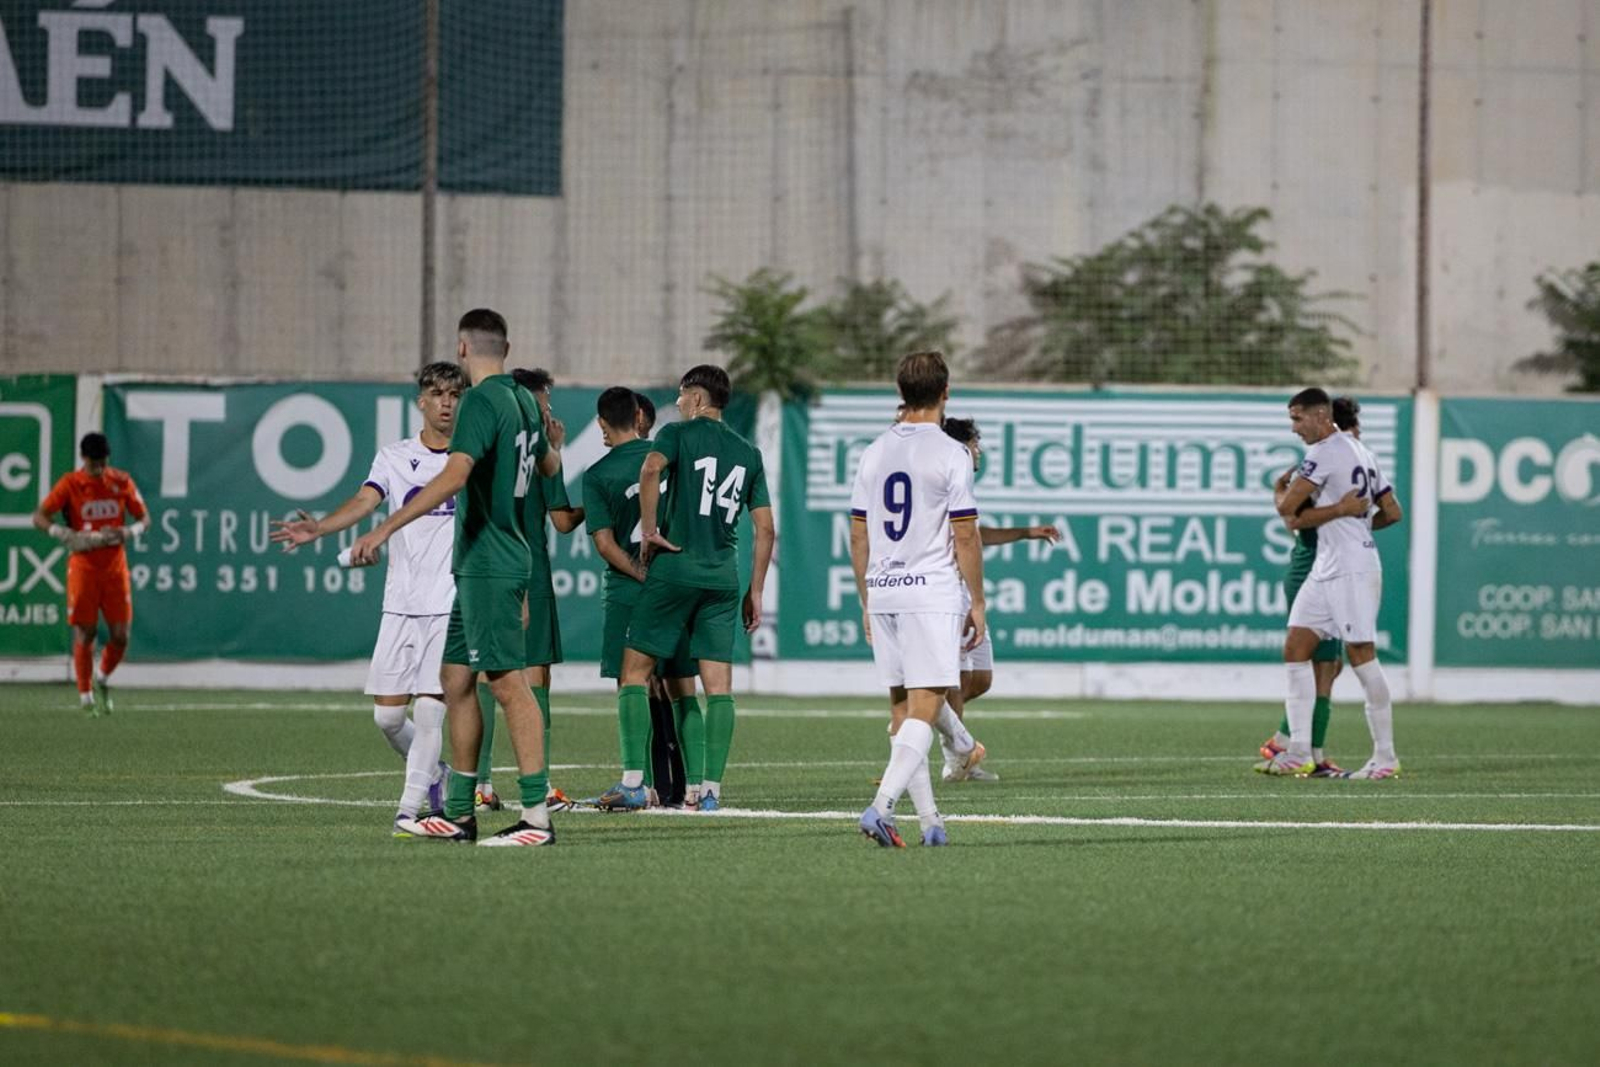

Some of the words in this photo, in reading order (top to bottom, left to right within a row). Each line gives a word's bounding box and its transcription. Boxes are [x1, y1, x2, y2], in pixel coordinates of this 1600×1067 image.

[694, 456, 747, 525] 14
[884, 471, 912, 542] 9
[1100, 517, 1246, 564] REAL
[132, 565, 198, 592] 953
[216, 567, 278, 592] 351
[303, 566, 366, 593] 108
[866, 573, 927, 588] alderón
[1043, 570, 1110, 614] de
[1126, 570, 1289, 615] Moldu
[804, 619, 858, 646] 953
